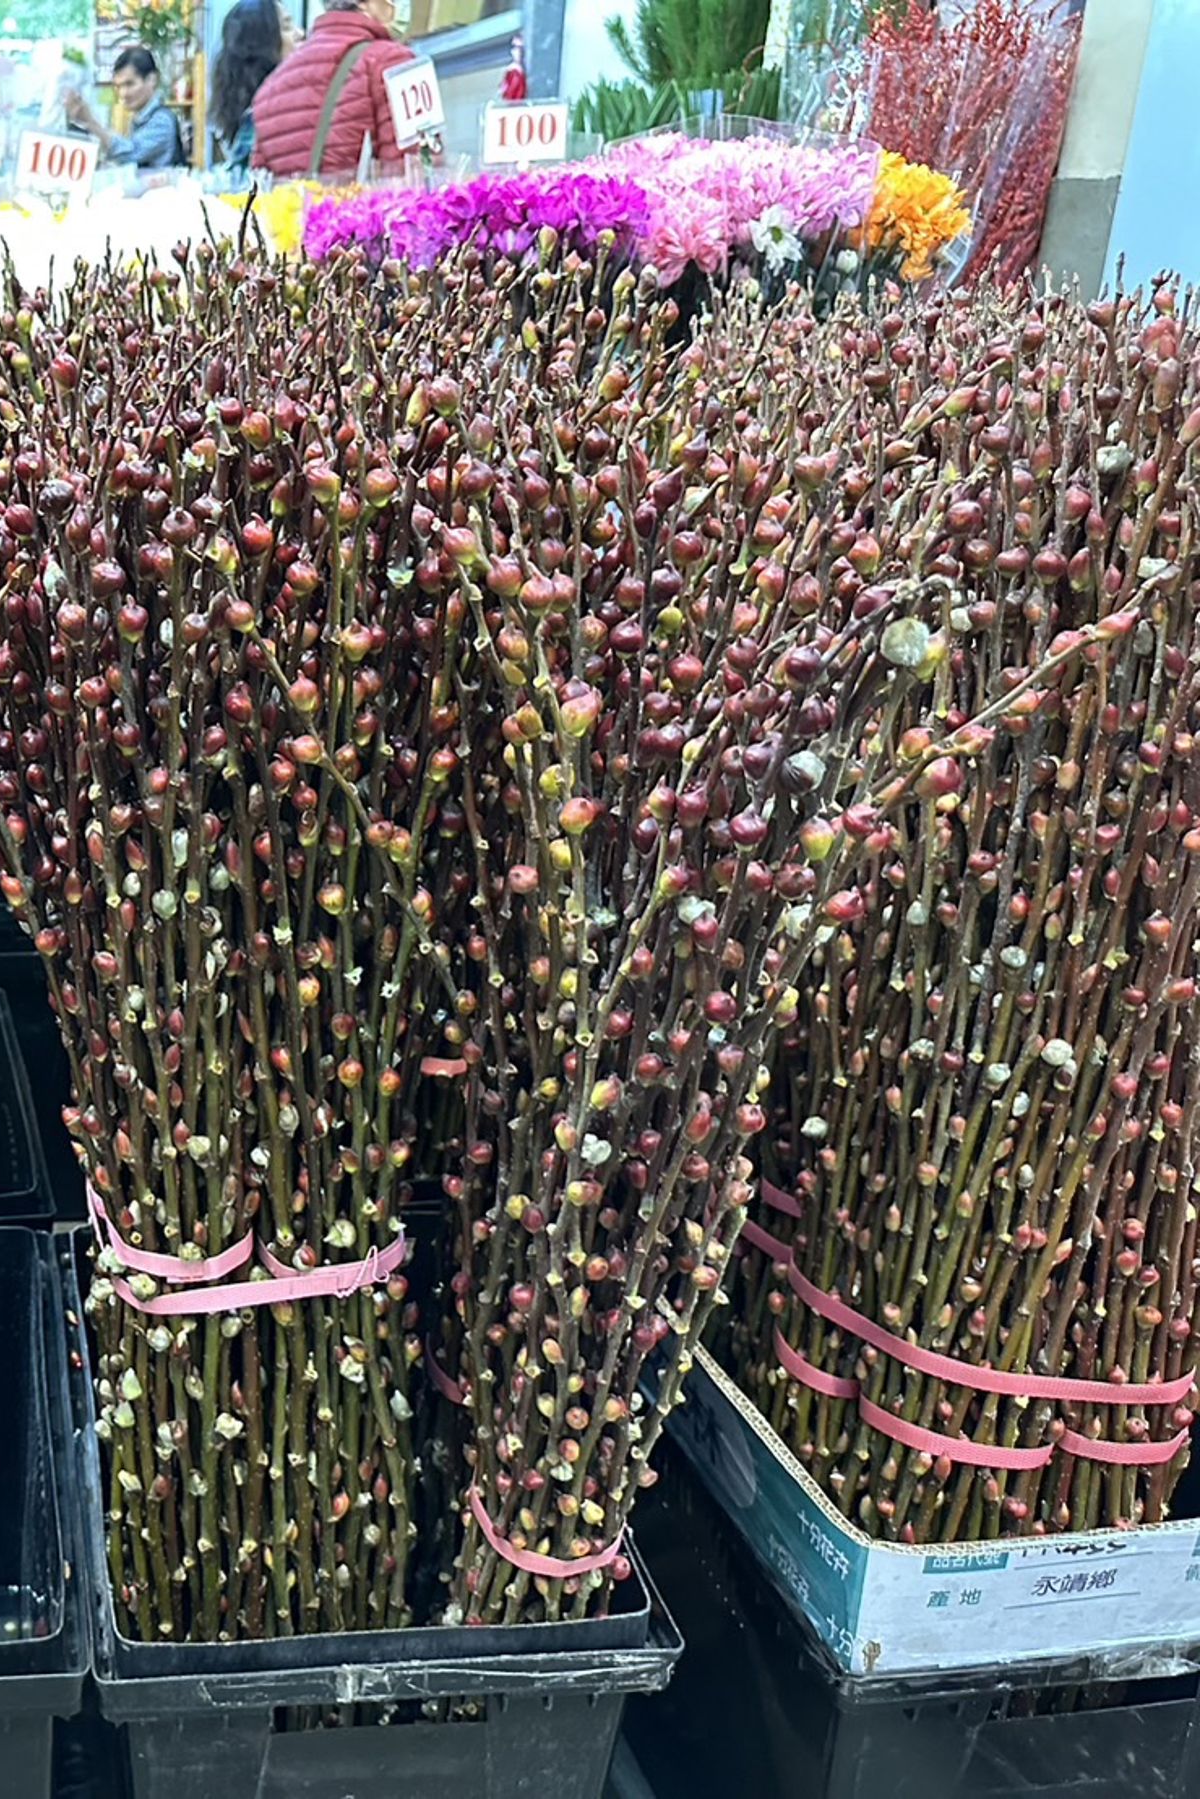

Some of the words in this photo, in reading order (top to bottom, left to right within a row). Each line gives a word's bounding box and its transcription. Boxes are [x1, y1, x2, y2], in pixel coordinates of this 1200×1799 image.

[401, 80, 433, 121] 120
[498, 112, 557, 147] 100
[30, 140, 86, 181] 100
[797, 1510, 849, 1580] 十分花卉
[1031, 1568, 1118, 1597] 永靖鄉
